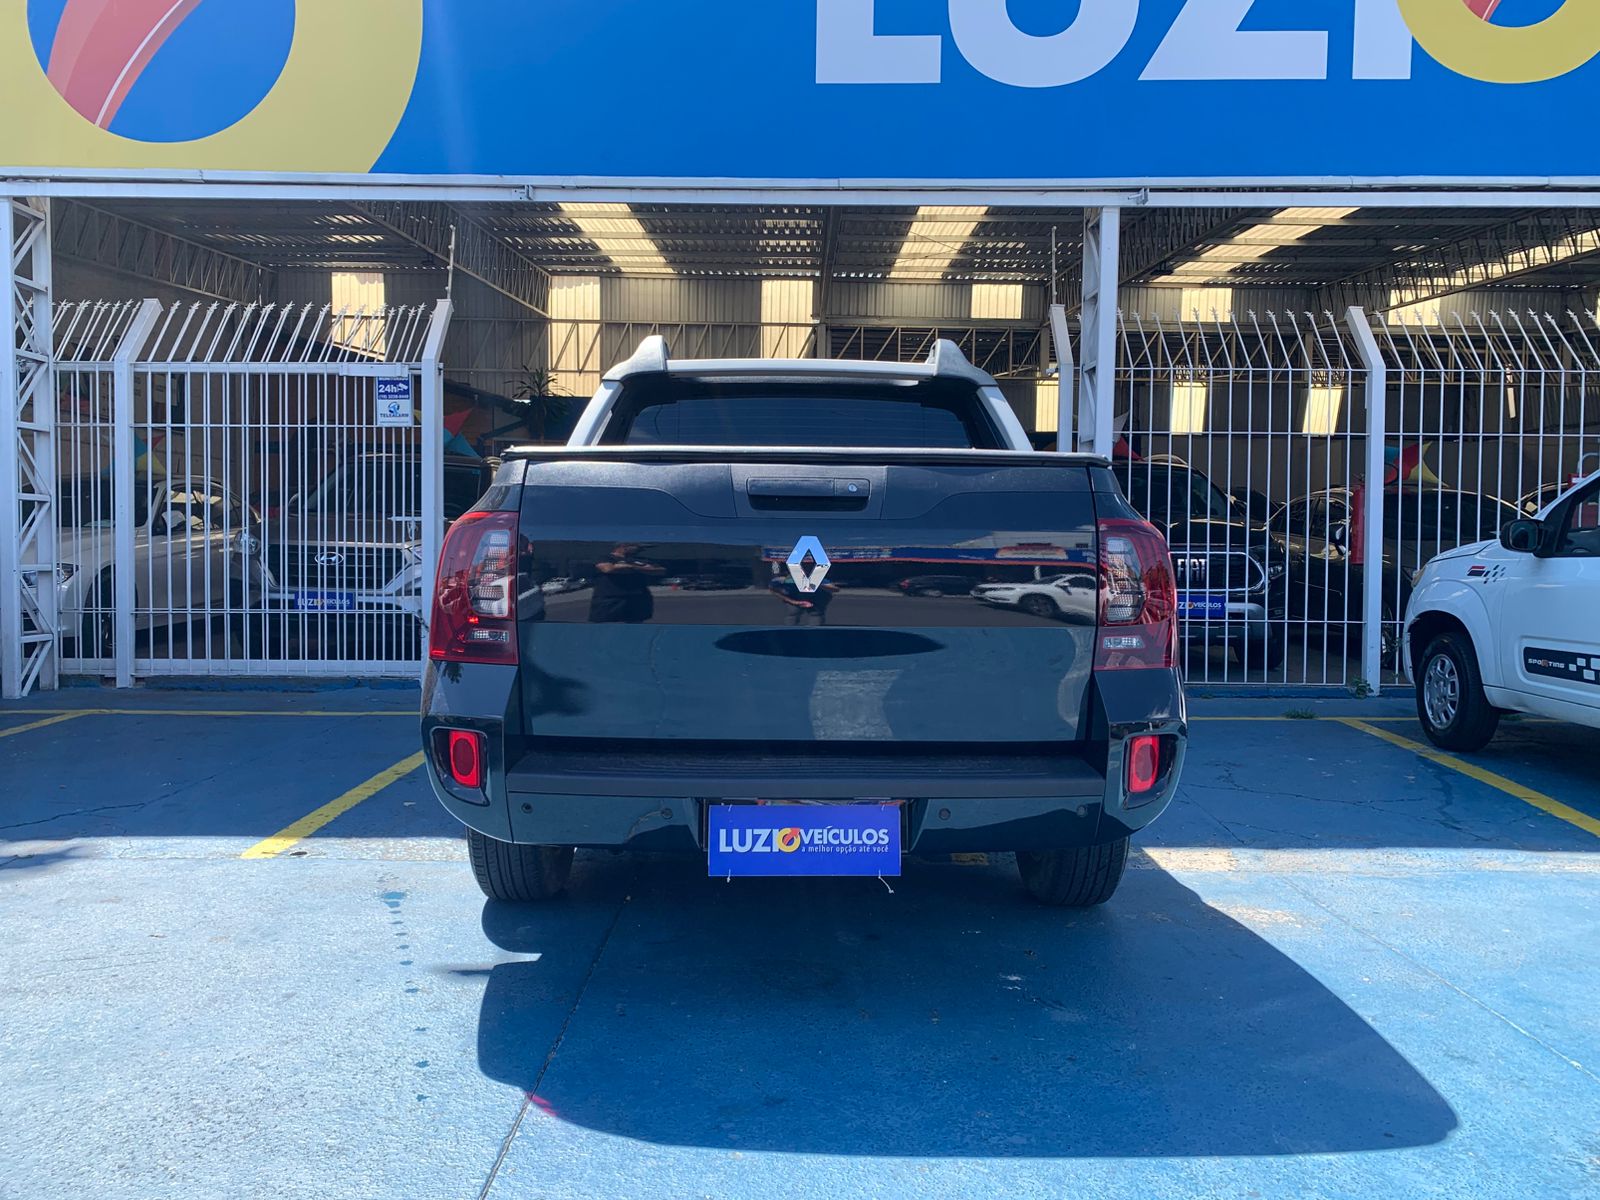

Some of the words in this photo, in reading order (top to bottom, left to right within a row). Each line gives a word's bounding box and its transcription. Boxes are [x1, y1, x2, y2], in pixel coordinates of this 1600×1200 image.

[379, 384, 397, 393] 24h
[719, 827, 801, 853] LUZIO
[799, 825, 890, 845] VEÍCULOS
[808, 845, 833, 853] melhor
[835, 846, 857, 855] opção
[859, 845, 871, 853] até
[873, 845, 889, 853] você
